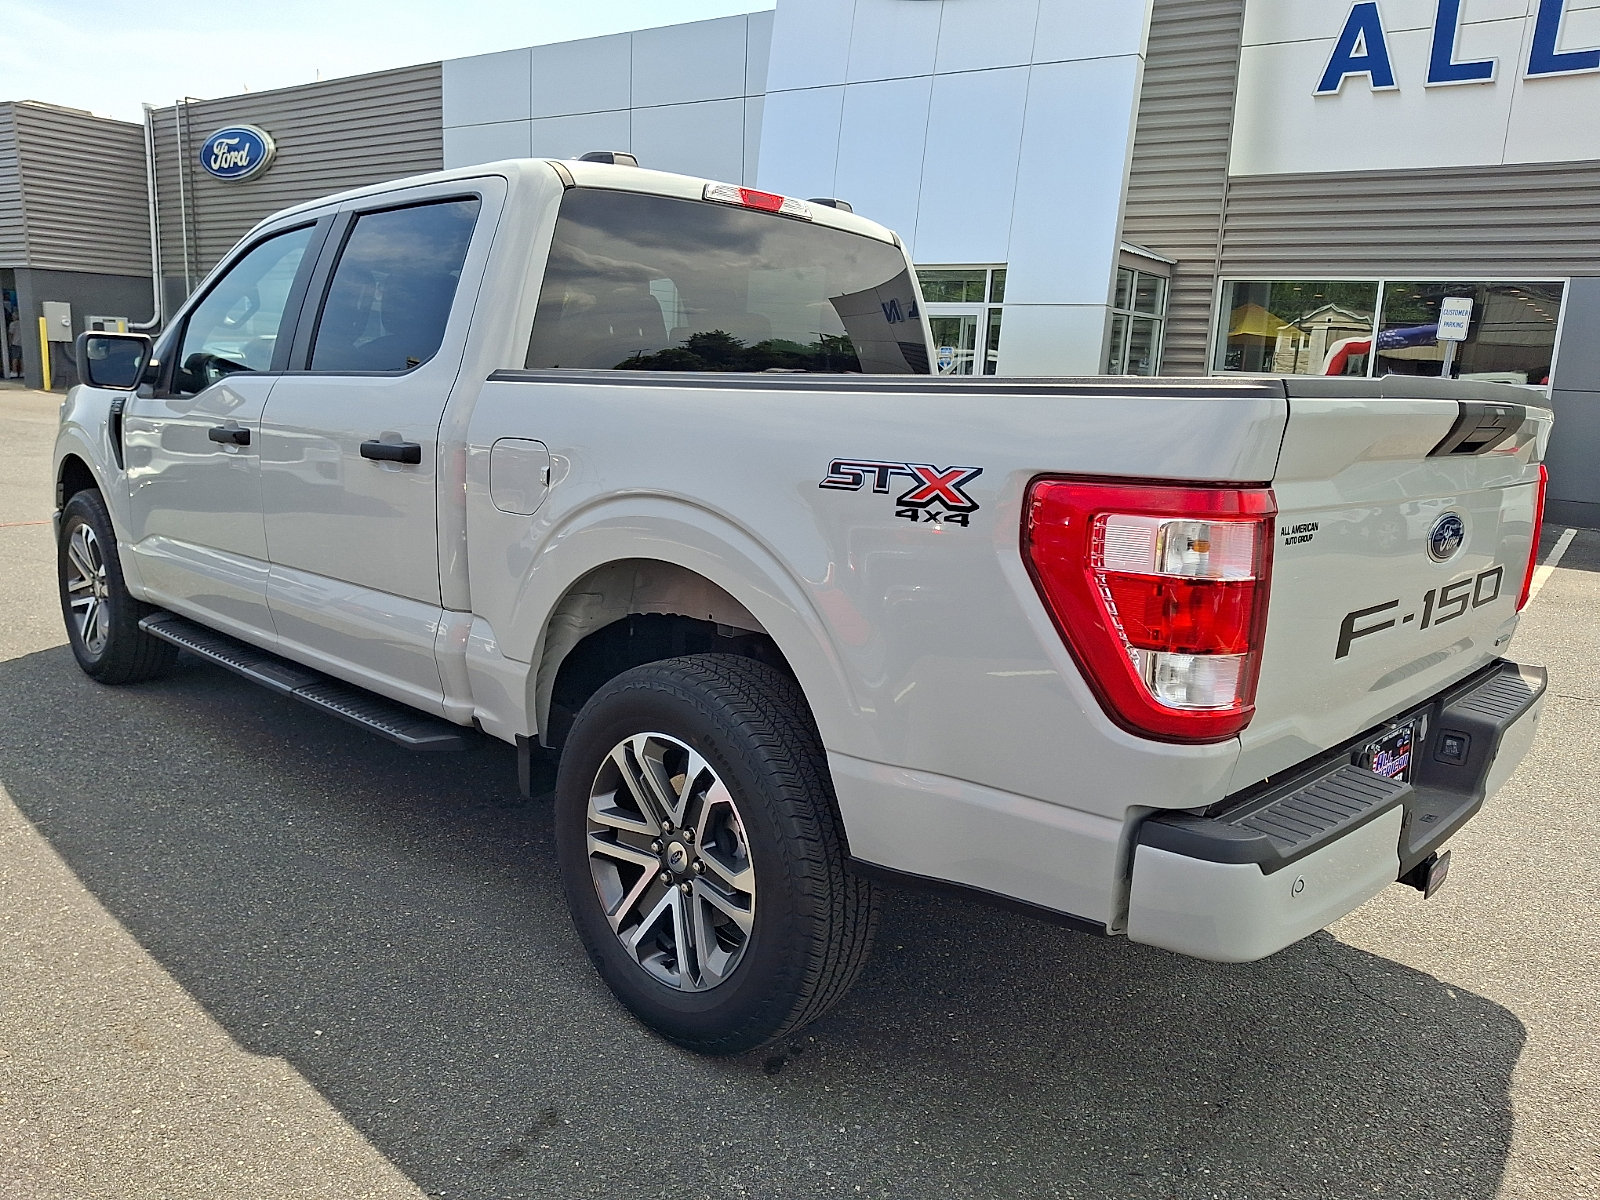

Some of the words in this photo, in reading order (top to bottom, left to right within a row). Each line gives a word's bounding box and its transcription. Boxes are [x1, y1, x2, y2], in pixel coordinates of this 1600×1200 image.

[1312, 0, 1600, 96] ALL
[211, 137, 250, 170] Ford
[819, 458, 984, 513] STX
[1281, 526, 1290, 536] ALL
[1291, 522, 1319, 534] AMERICAN
[1285, 536, 1297, 545] AUTO
[1298, 534, 1313, 543] GROUP
[1335, 566, 1503, 660] F-150
